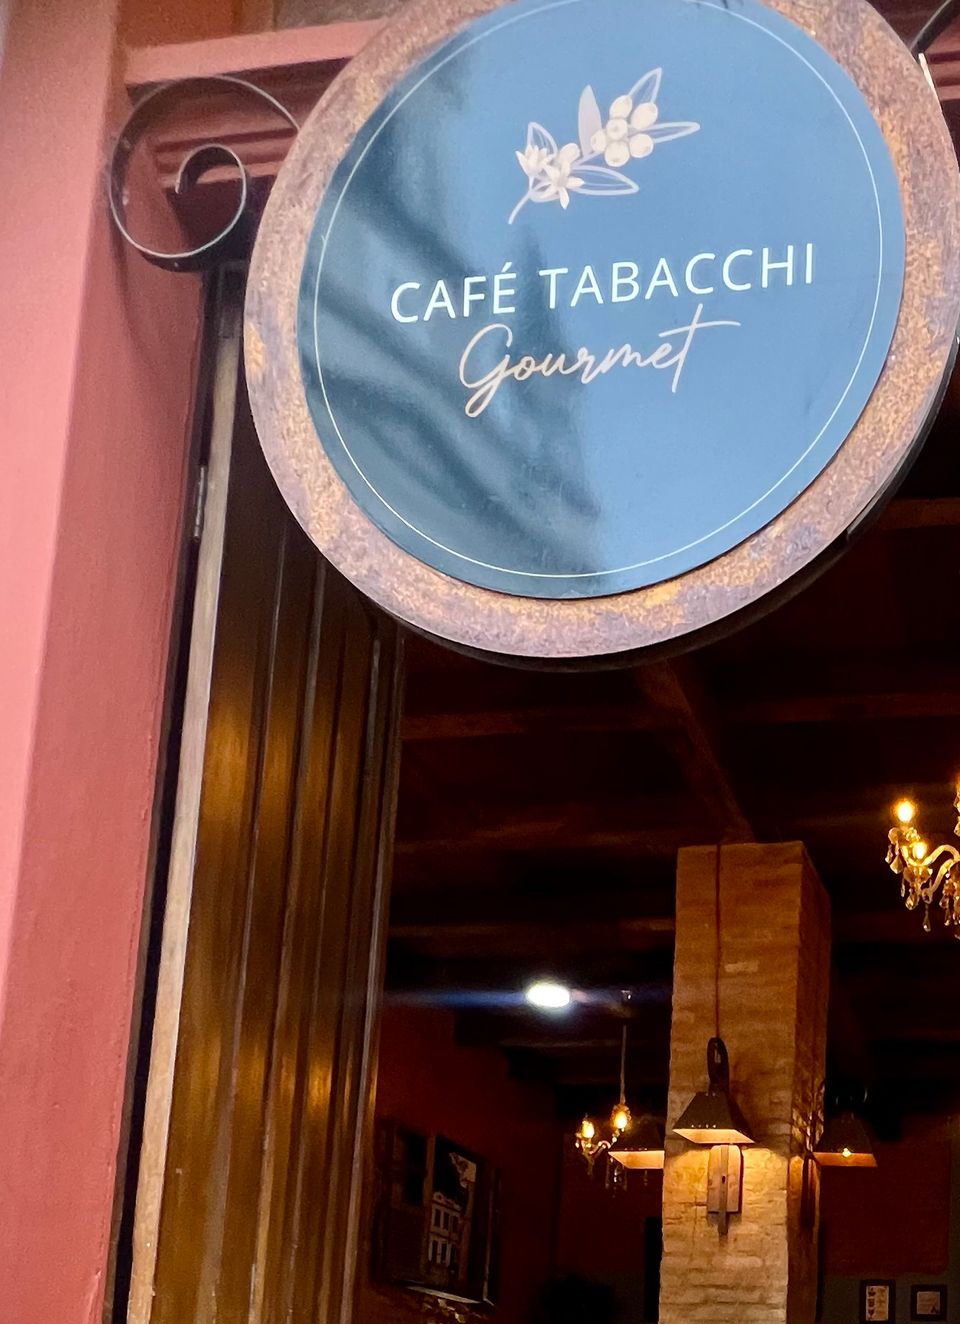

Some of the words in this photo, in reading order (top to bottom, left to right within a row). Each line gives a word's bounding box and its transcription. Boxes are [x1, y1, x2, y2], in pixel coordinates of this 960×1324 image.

[390, 261, 517, 323] CAFÉ
[538, 242, 814, 309] TABACCHI
[459, 303, 741, 418] Gourmet
